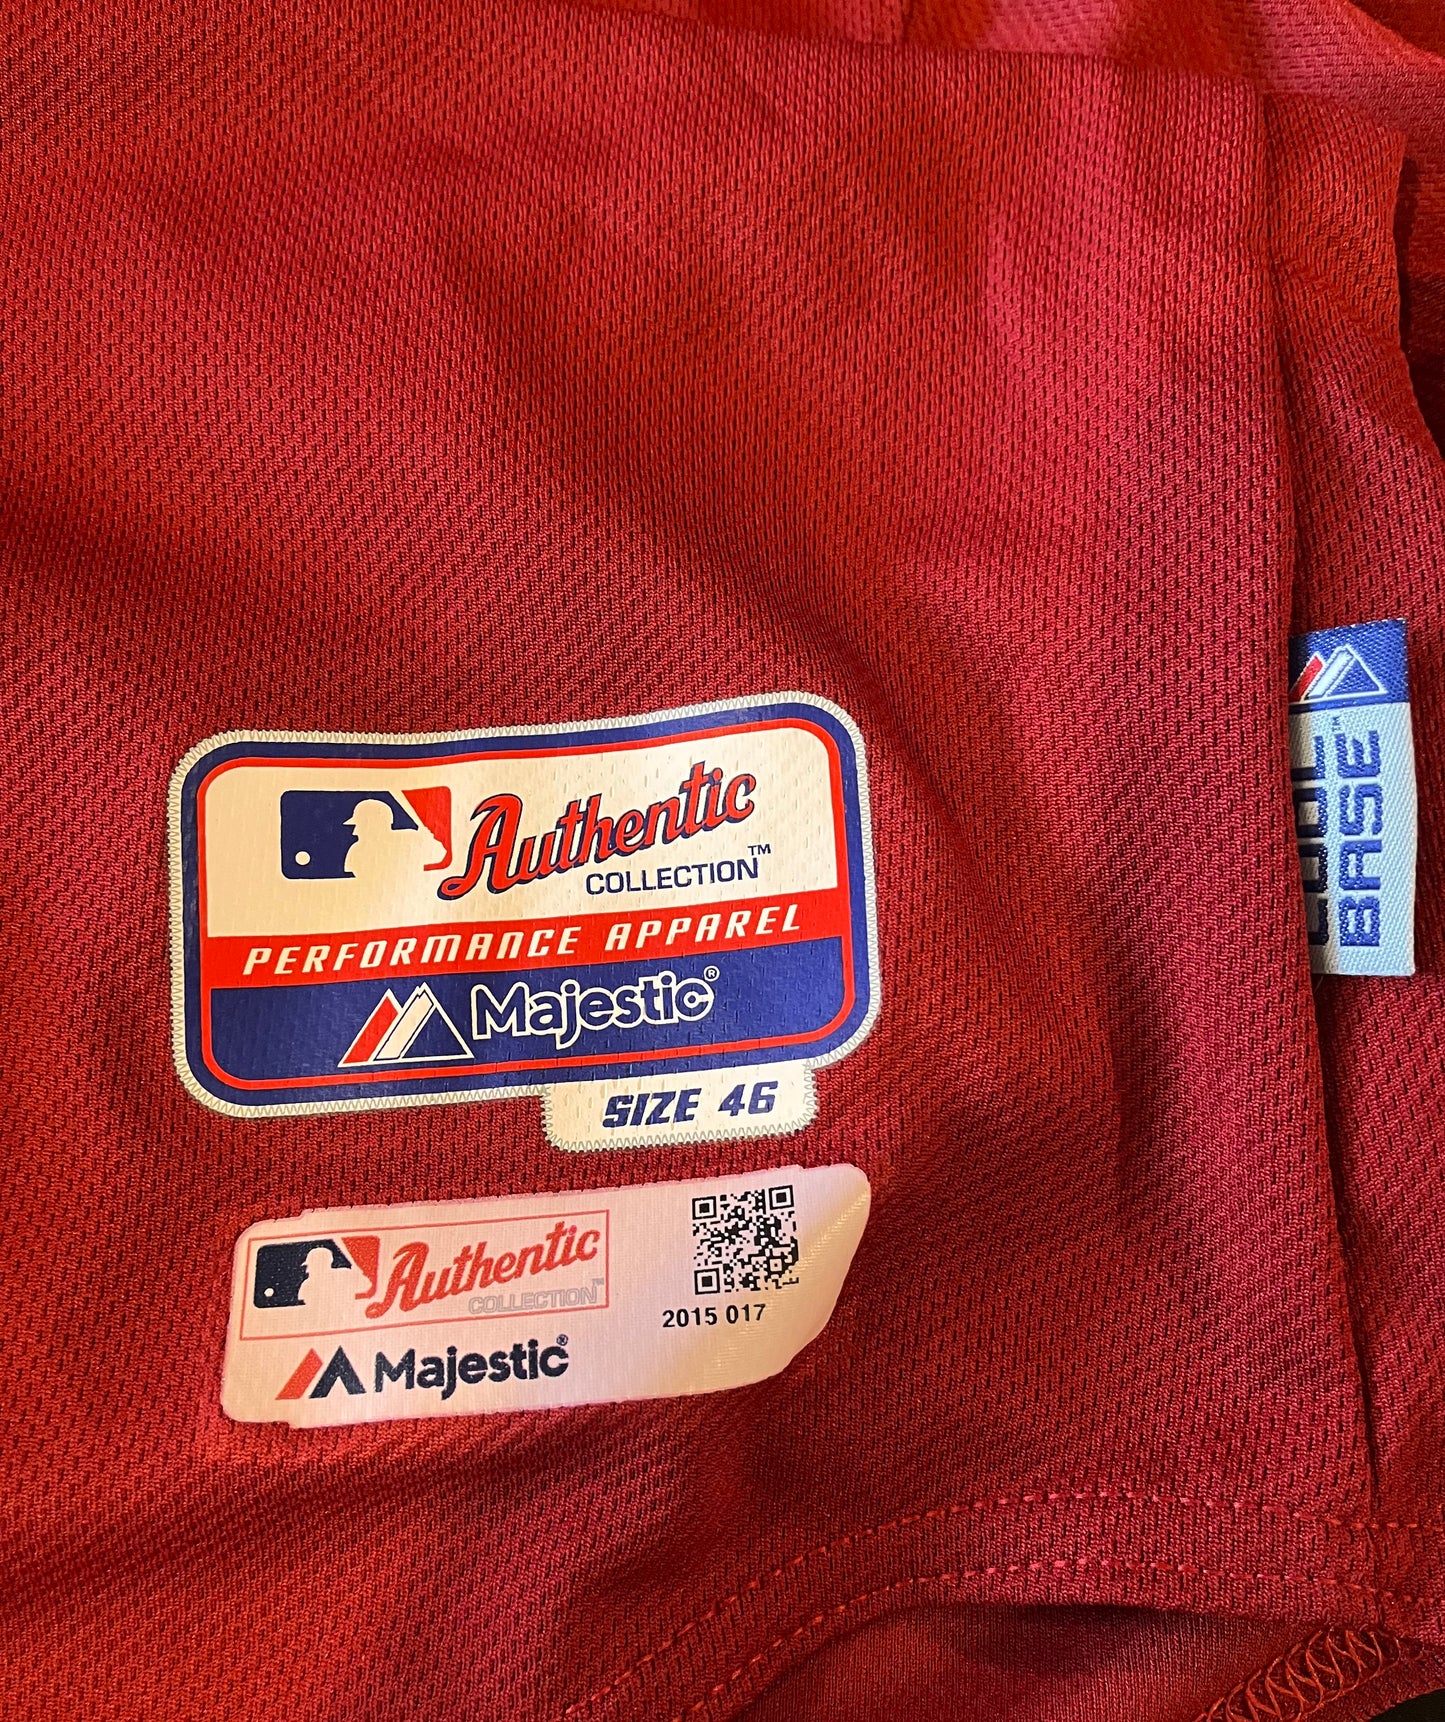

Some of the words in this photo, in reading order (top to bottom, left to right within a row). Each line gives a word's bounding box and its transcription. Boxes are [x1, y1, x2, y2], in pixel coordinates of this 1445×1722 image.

[436, 760, 757, 901] Authentic
[241, 926, 582, 976] PERFORMANCE
[604, 904, 801, 951] APPAREL
[601, 1088, 703, 1128] SIZE
[717, 1080, 779, 1117] 46
[365, 1220, 601, 1319] Authentic
[662, 1306, 718, 1328] 2015
[725, 1303, 766, 1324] 017
